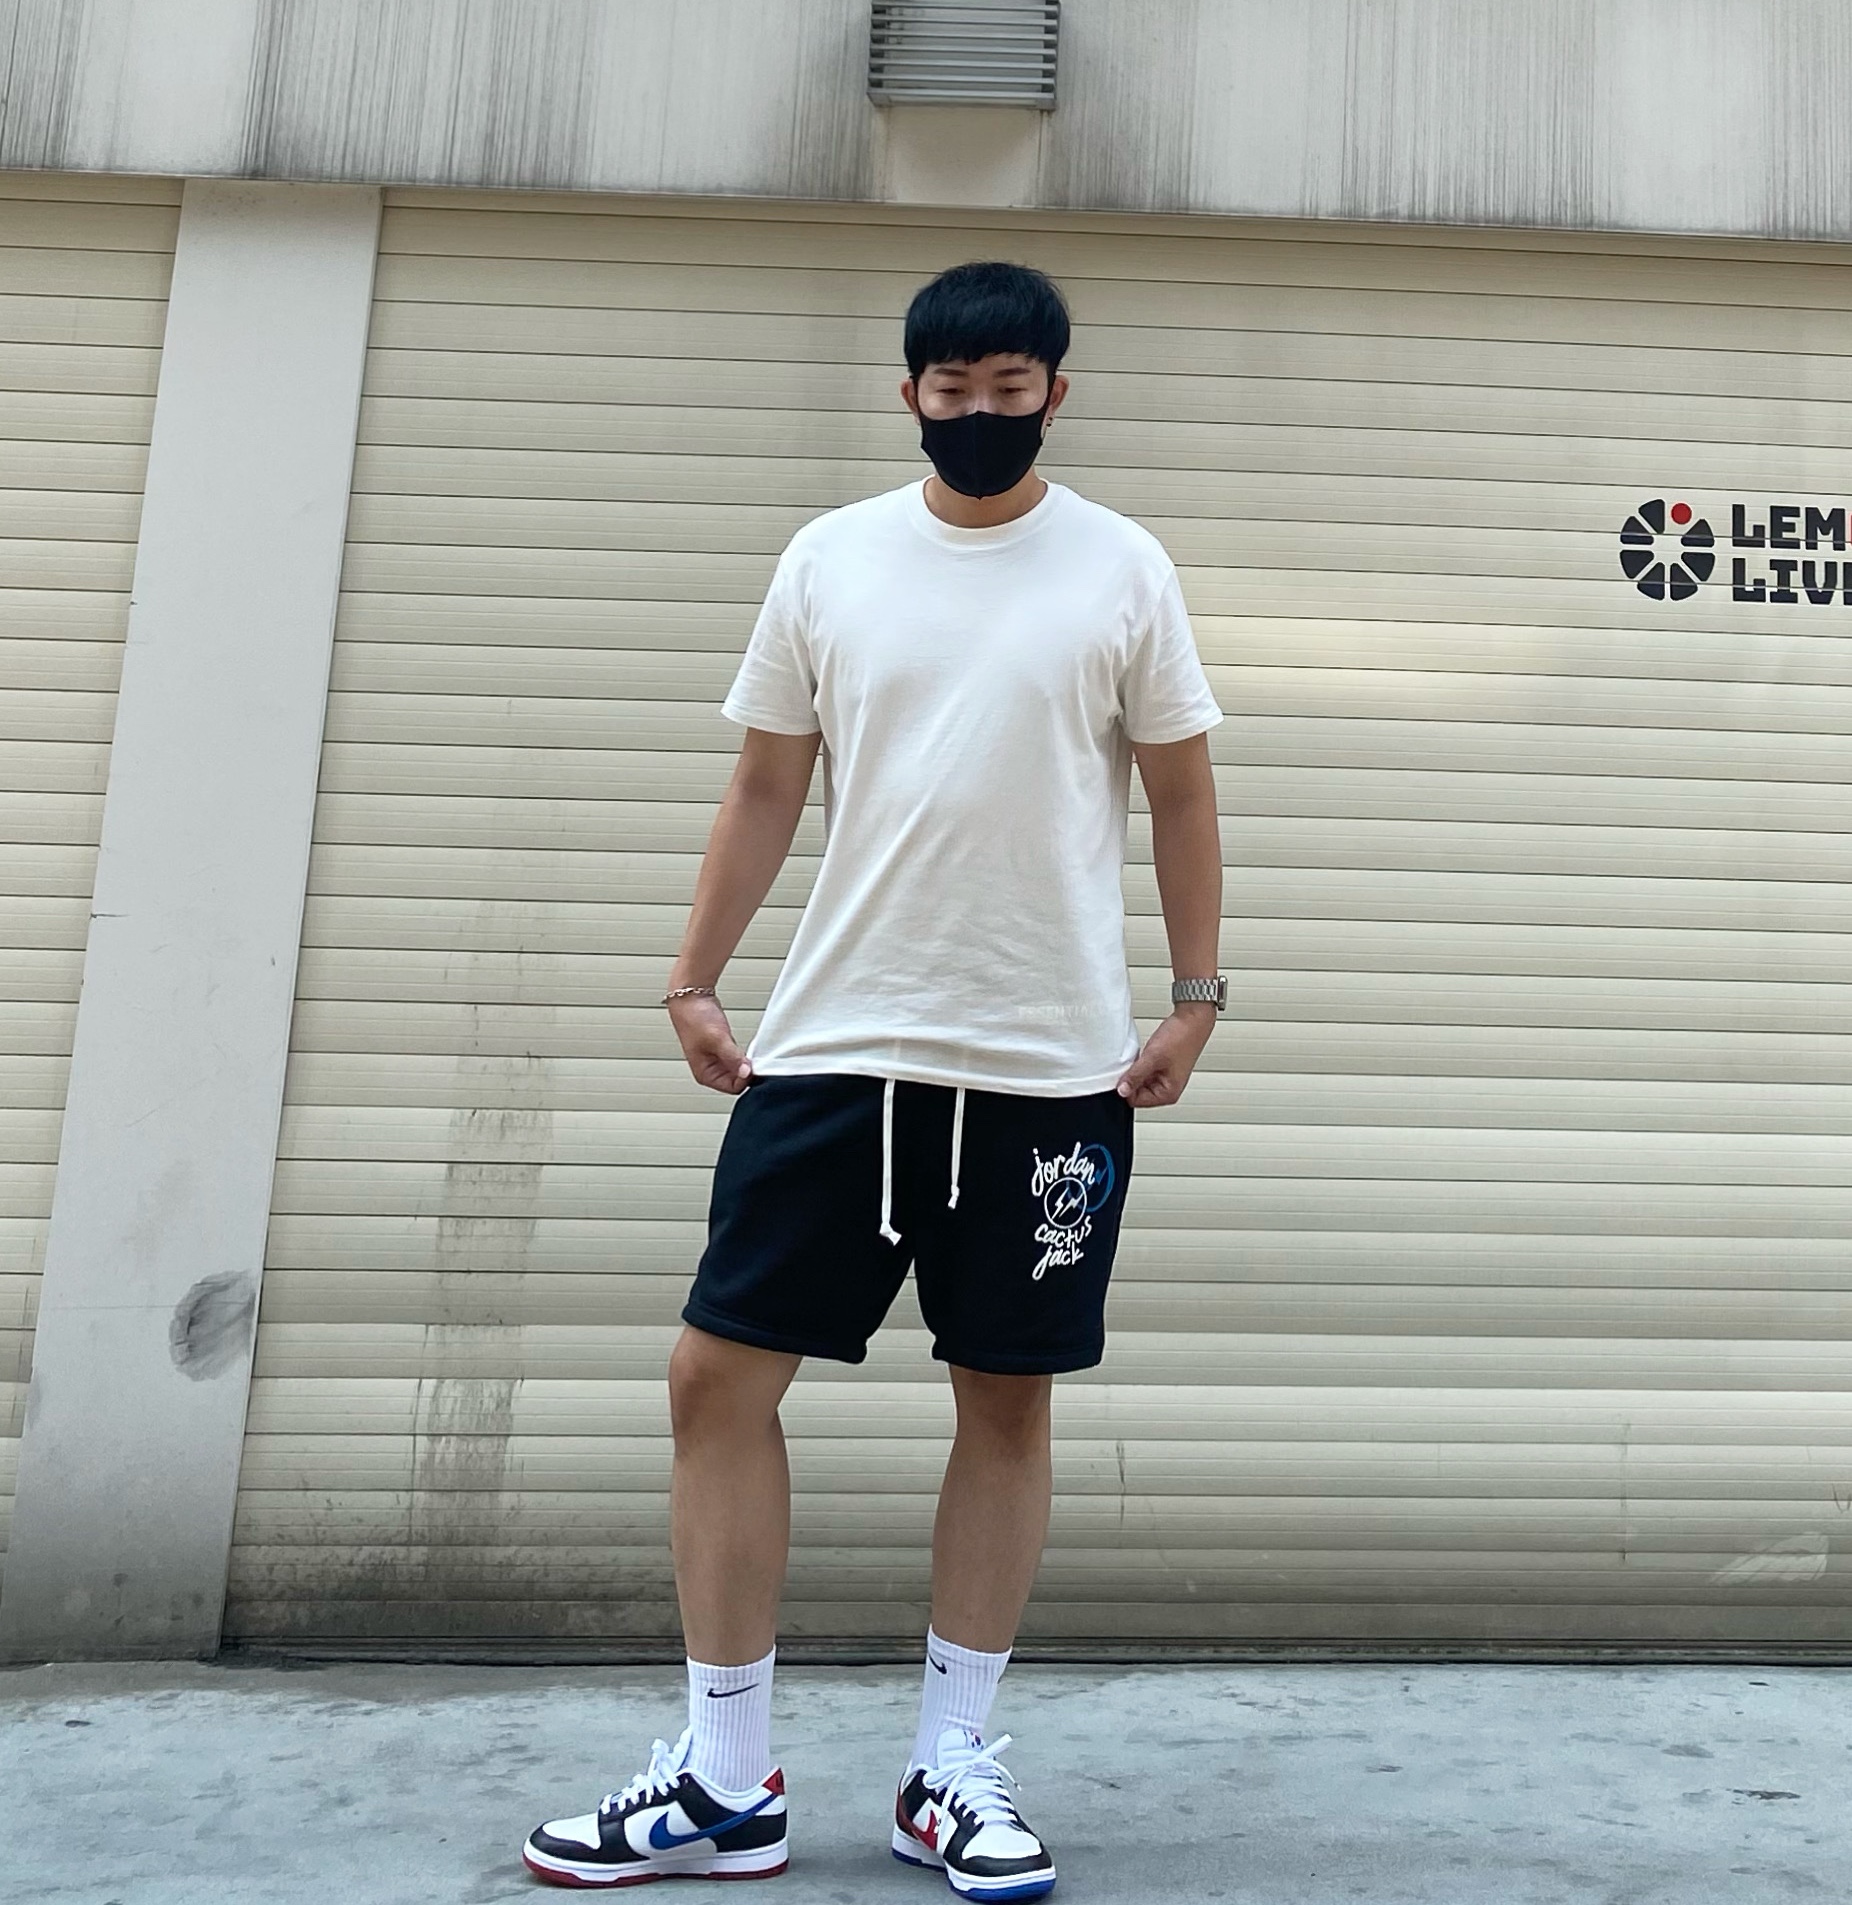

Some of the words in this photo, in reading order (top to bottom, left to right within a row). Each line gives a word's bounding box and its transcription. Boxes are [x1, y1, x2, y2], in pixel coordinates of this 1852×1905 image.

[1732, 504, 1852, 551] LEM
[1031, 1141, 1096, 1197] jordan
[1034, 1215, 1092, 1248] cactus
[1031, 1241, 1084, 1281] jack
